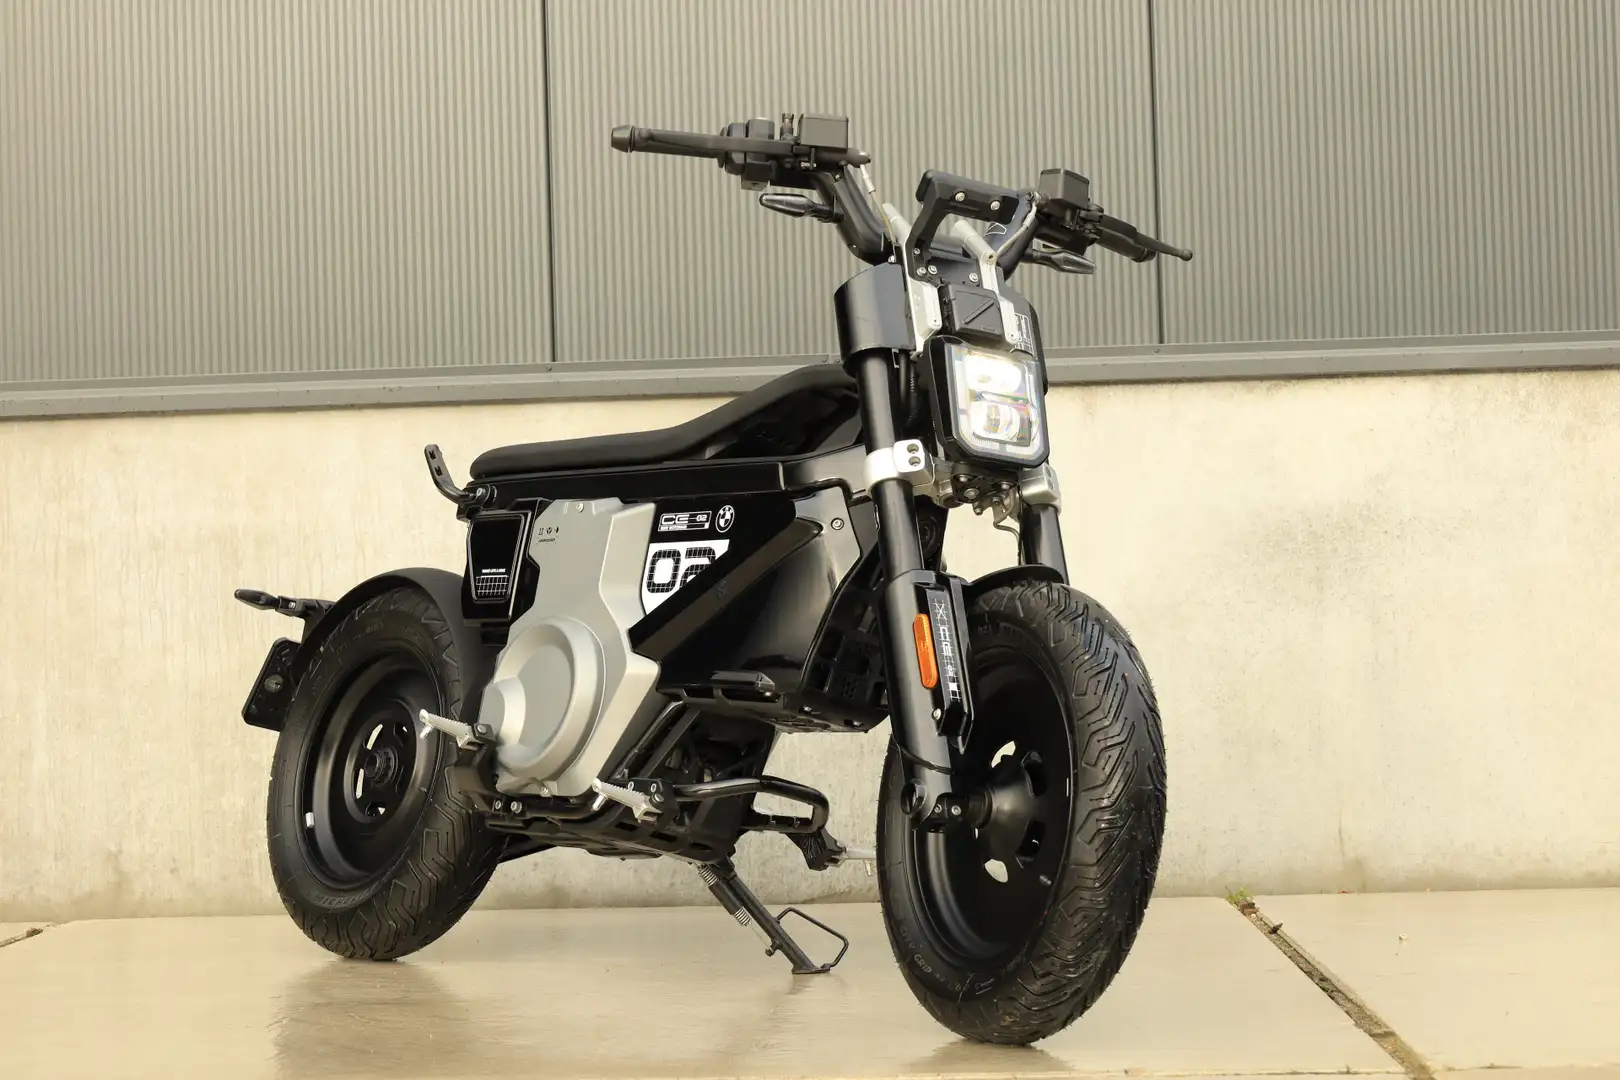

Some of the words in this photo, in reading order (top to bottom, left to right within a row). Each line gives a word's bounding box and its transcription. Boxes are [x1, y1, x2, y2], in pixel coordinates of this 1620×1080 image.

[661, 514, 690, 525] CE
[696, 514, 708, 522] 02
[914, 954, 932, 973] GRIP
